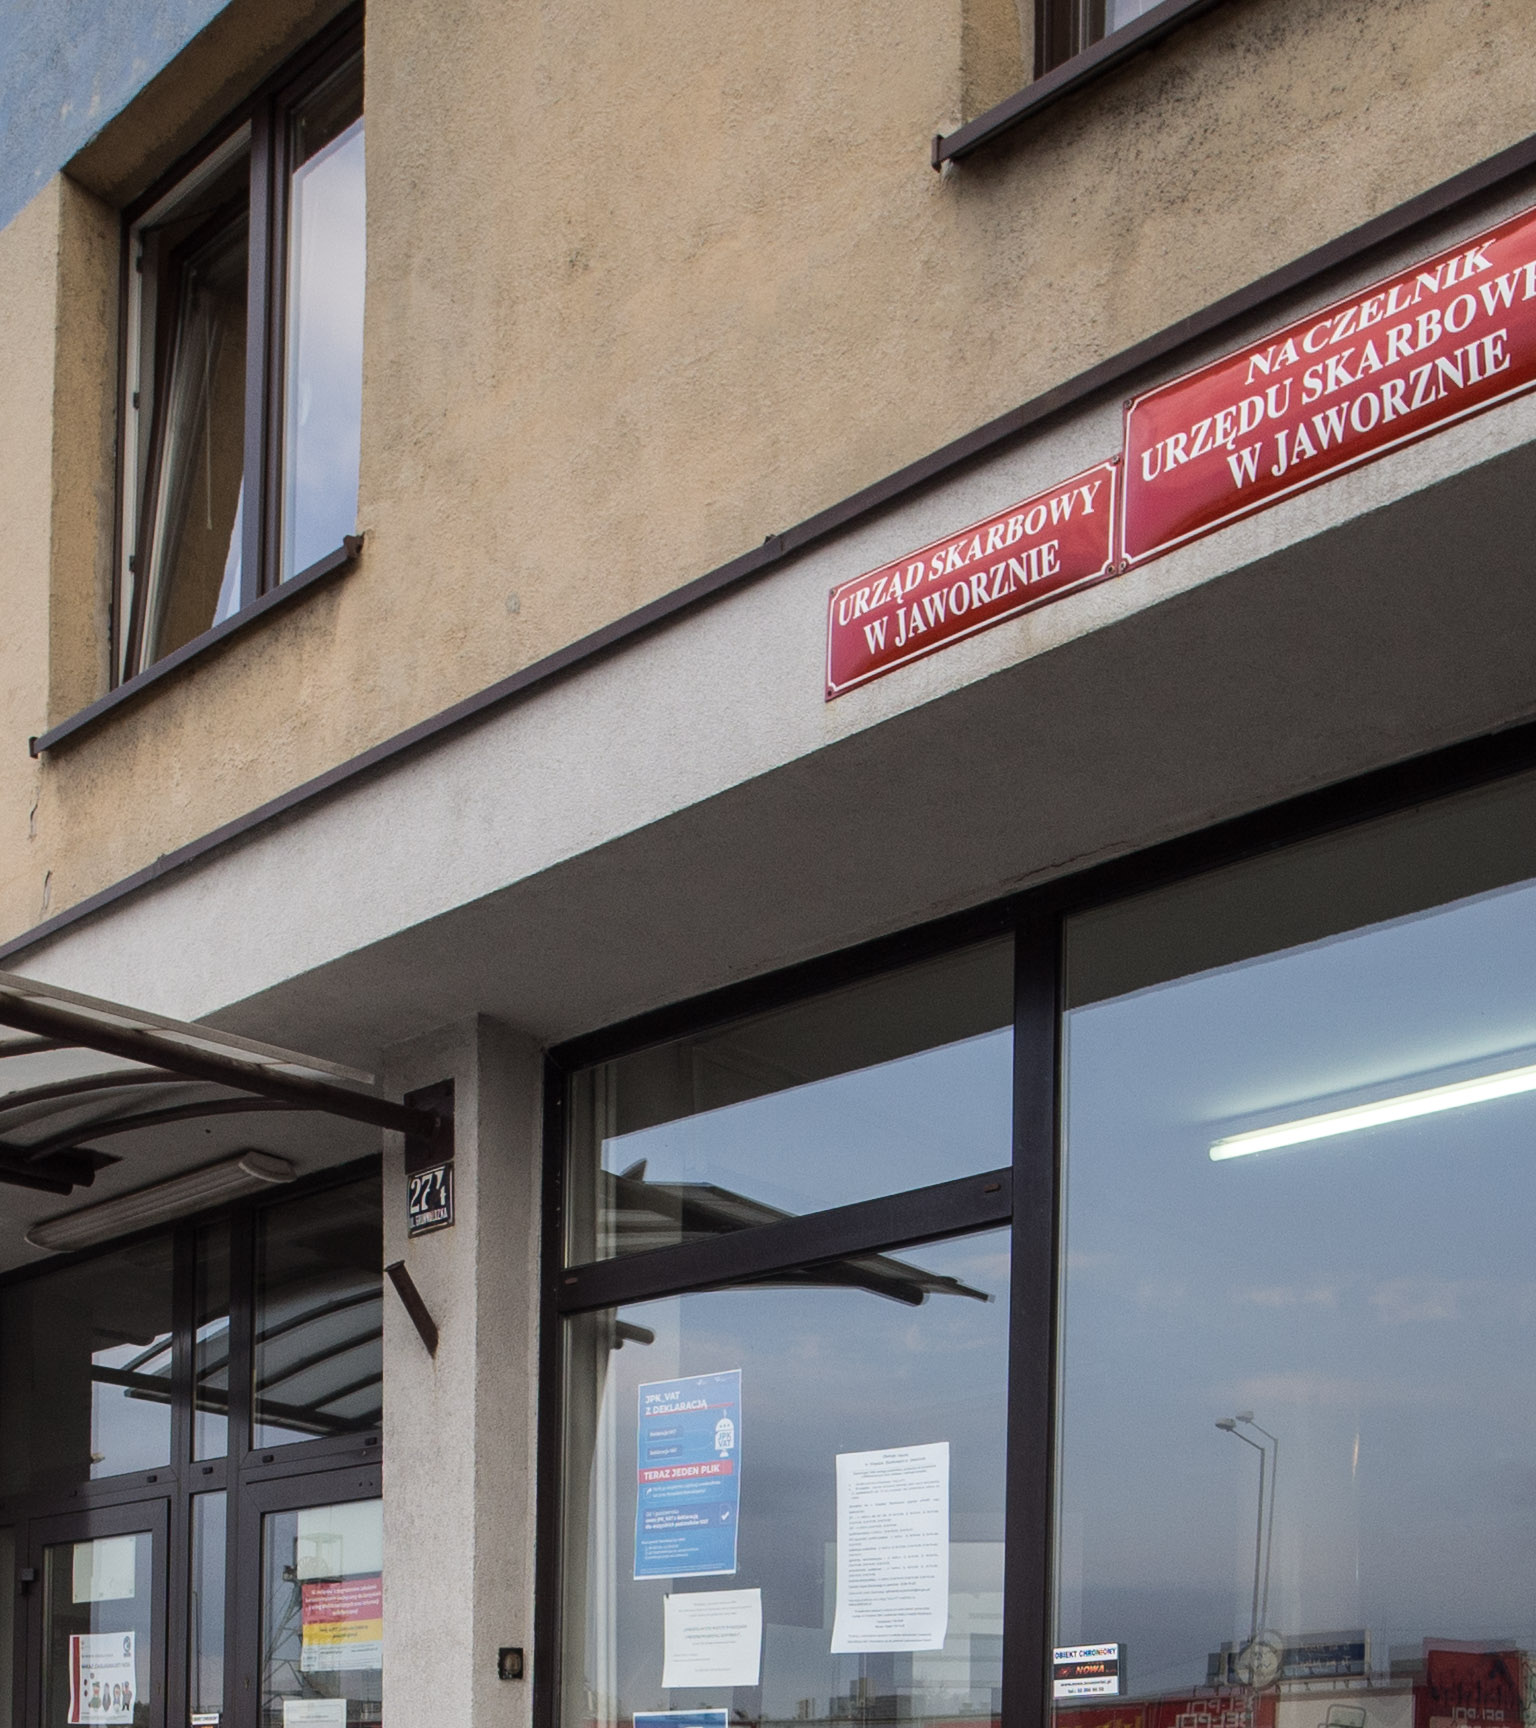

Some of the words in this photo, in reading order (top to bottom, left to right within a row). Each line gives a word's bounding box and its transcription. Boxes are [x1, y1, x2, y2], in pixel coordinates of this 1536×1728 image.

[1245, 237, 1497, 385] NACZELNIK
[1226, 447, 1265, 490] W
[1271, 329, 1512, 478] JAWORZNIE
[1141, 374, 1292, 484] URZĘDU
[838, 558, 926, 628] URZĄD
[929, 480, 1105, 584] SKARBOWY
[863, 616, 893, 656] W
[894, 540, 1062, 649] JAWORZNIE
[645, 1407, 652, 1415] Z
[653, 1399, 708, 1414] DEKLARACJĄ
[718, 1431, 732, 1441] JPK
[718, 1439, 732, 1448] VAT
[644, 1469, 670, 1481] TERAZ
[672, 1466, 699, 1478] JEDEN
[701, 1463, 720, 1475] PLIK
[1055, 1650, 1077, 1660] OBIEKT
[1079, 1647, 1116, 1658] CHRONIONY
[1075, 1664, 1105, 1675] NOWA
